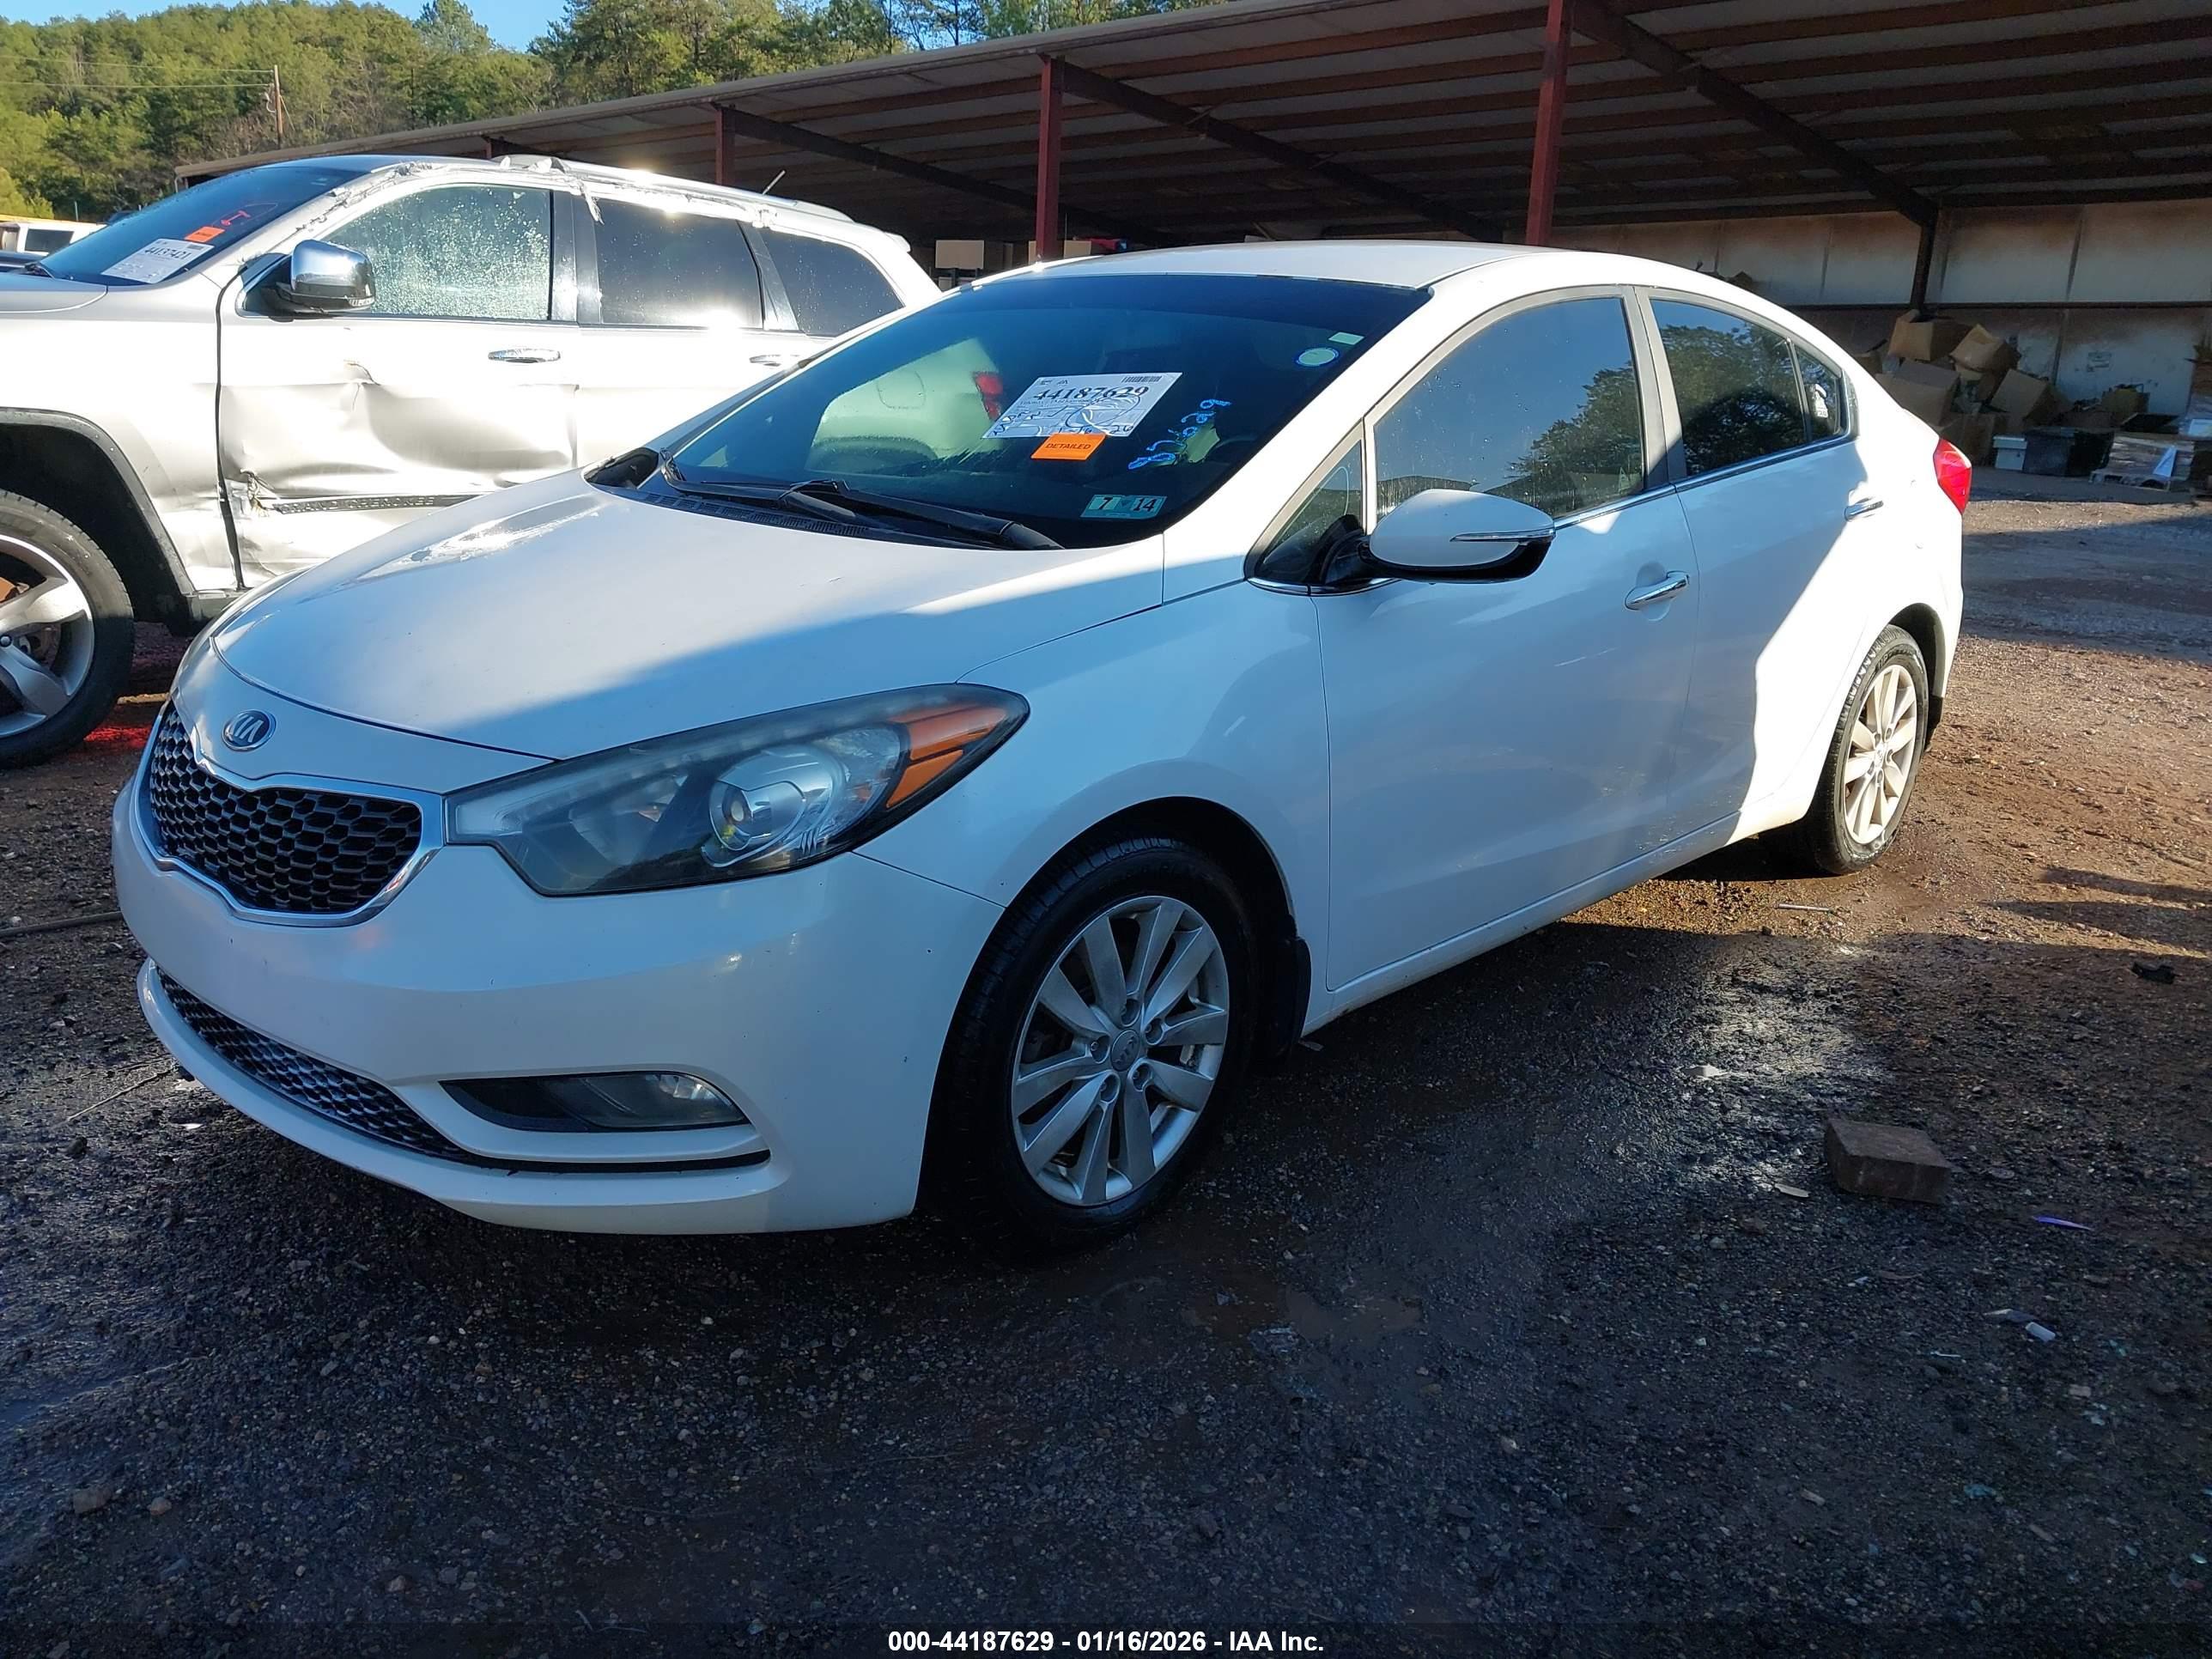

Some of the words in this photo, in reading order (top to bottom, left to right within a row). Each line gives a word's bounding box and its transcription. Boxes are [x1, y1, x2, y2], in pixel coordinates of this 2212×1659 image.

[1033, 386, 1150, 400] 44187629
[279, 500, 339, 514] GRAND
[344, 496, 434, 508] CHEROKEE
[1098, 496, 1114, 510] 7
[1133, 498, 1158, 512] 14
